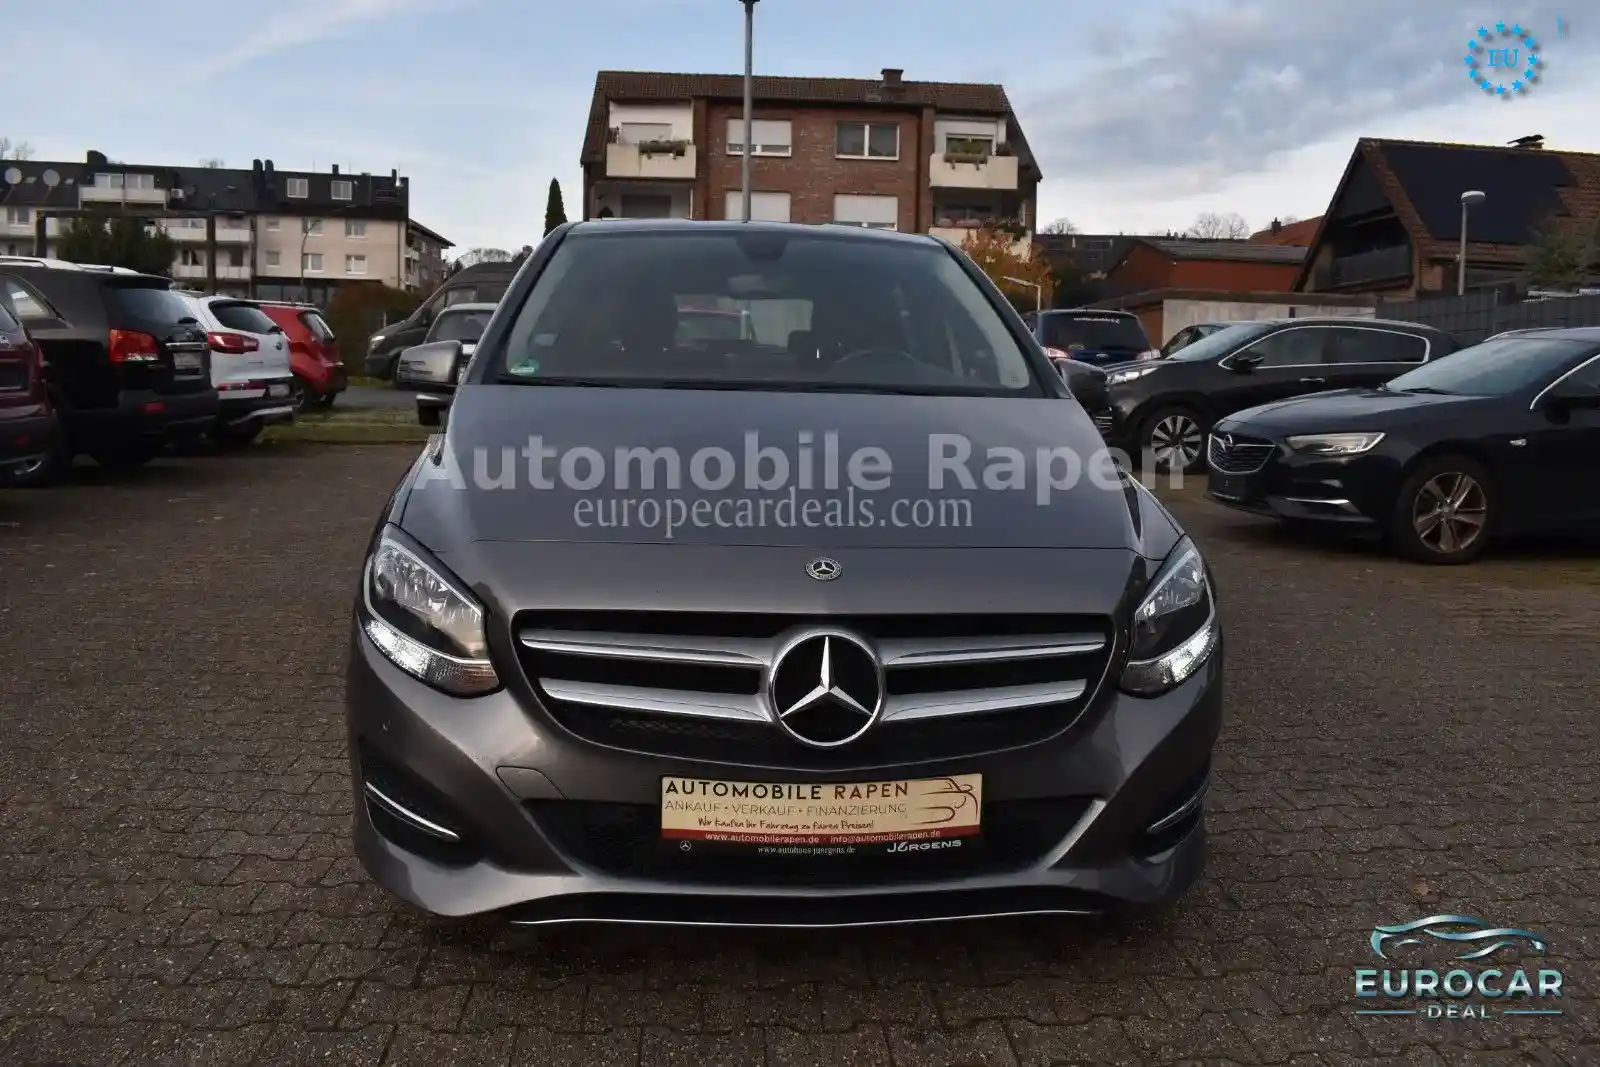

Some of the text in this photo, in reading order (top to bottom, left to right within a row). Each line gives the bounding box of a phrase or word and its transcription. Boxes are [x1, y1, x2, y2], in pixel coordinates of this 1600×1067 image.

[665, 780, 908, 800] AUTOMOBILE RAPEN
[664, 800, 908, 817] ANKAUF VERKAUF FINANZIERUNG
[698, 816, 712, 827] Wir
[760, 819, 799, 832] Fahrzeug
[812, 821, 839, 830] fairen
[705, 829, 941, 844] www.automobilerapen.de info@automobilerapen.de
[757, 845, 856, 856] www.autohaus-juergens.de
